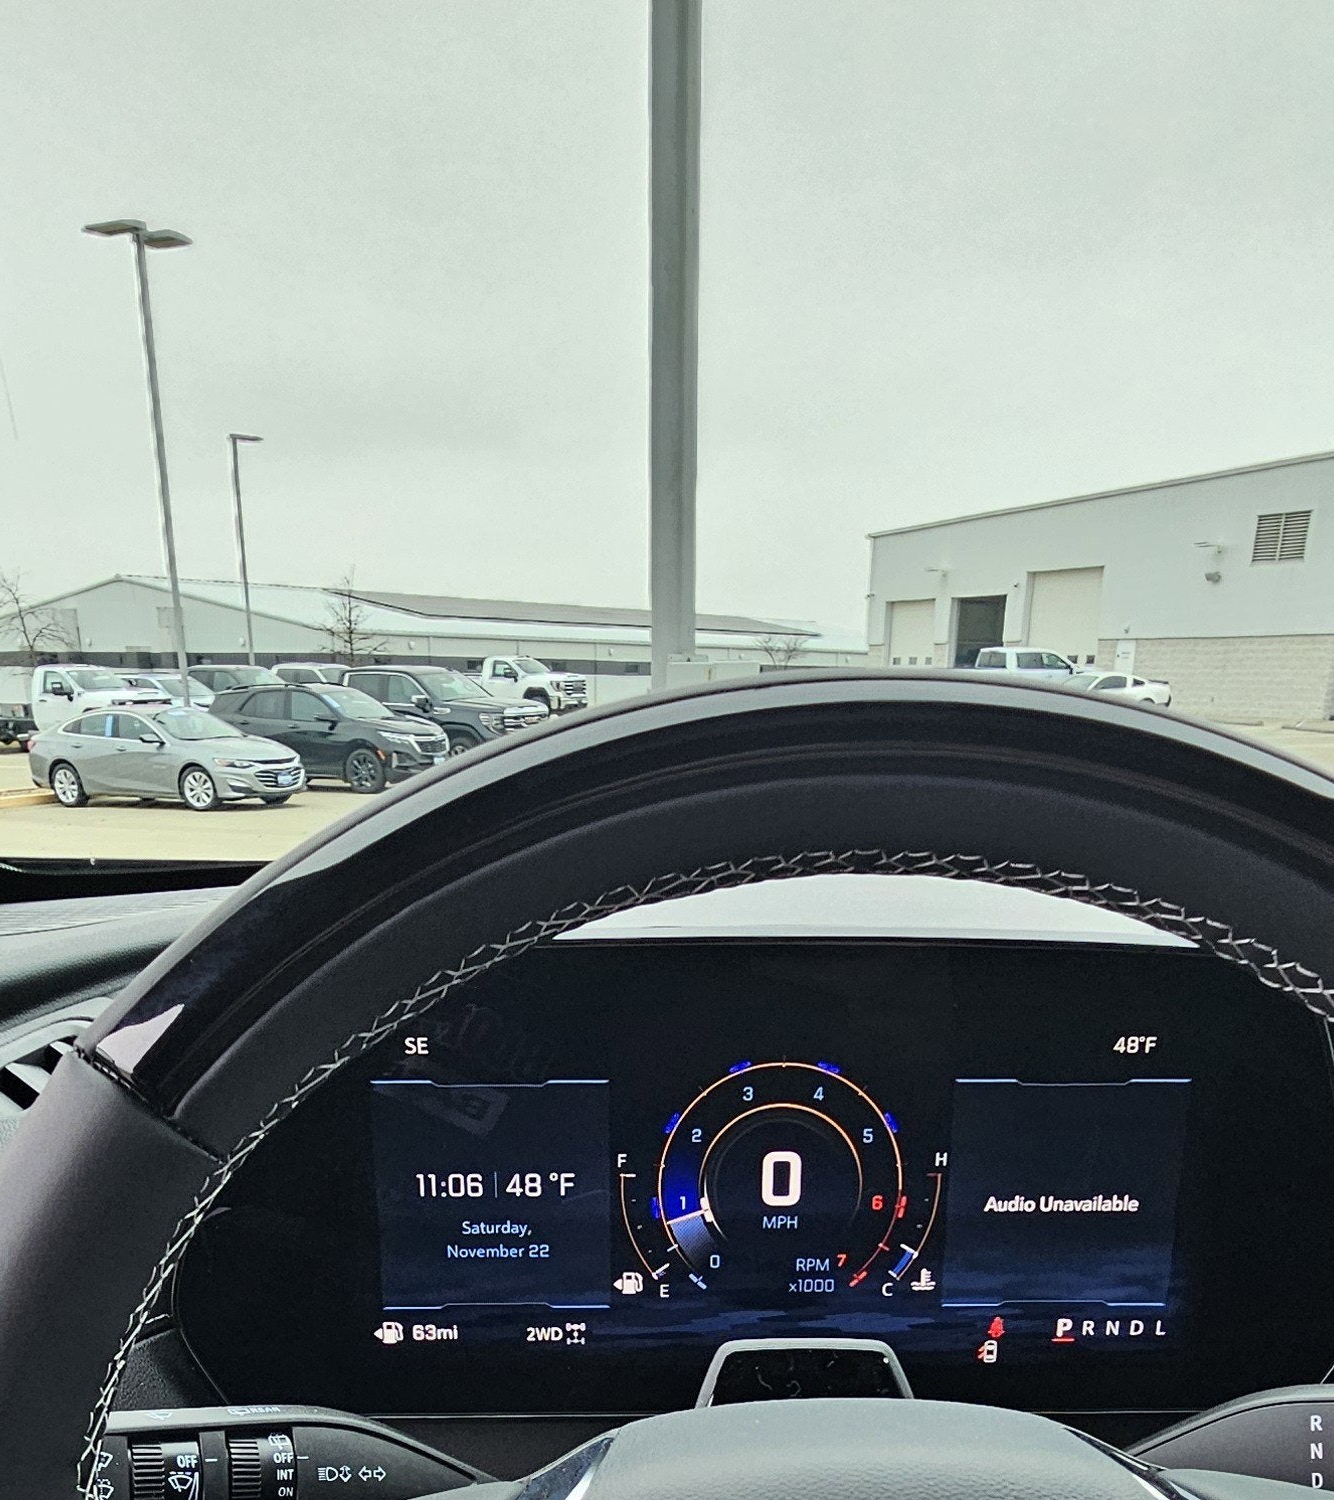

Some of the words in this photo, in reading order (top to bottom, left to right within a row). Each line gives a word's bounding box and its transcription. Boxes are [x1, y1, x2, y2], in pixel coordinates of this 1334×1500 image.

[405, 1037, 428, 1054] SE
[743, 1087, 753, 1101] 3
[814, 1087, 824, 1100] 4
[692, 1129, 701, 1142] 2
[863, 1129, 873, 1143] 5
[618, 1154, 627, 1167] F
[935, 1152, 947, 1166] H
[416, 1174, 483, 1197] 11:06
[506, 1173, 541, 1196] 48
[762, 1151, 801, 1206] 0
[680, 1196, 685, 1210] 1
[872, 1195, 883, 1210] 6
[984, 1195, 1036, 1212] Audio
[1040, 1195, 1139, 1212] Unavailable
[462, 1220, 531, 1237] Saturday,
[763, 1216, 797, 1228] MPH
[447, 1244, 524, 1258] November
[529, 1244, 549, 1257] 22
[710, 1255, 720, 1268] 0
[796, 1258, 829, 1271] RPM
[837, 1254, 846, 1266] 7
[660, 1284, 669, 1297] E
[789, 1279, 834, 1292] x1000
[882, 1283, 893, 1296] C
[413, 1324, 458, 1340] 63mi
[527, 1327, 563, 1341] 2WD
[1056, 1318, 1072, 1337] P
[1082, 1321, 1094, 1335] R
[1106, 1321, 1119, 1335] N
[1130, 1320, 1144, 1335] D
[1156, 1320, 1166, 1335] L
[1311, 1415, 1322, 1431] R
[273, 1452, 293, 1463] OFF
[1310, 1443, 1323, 1459] N
[177, 1455, 197, 1468] OFF
[277, 1470, 294, 1480] INT
[279, 1487, 293, 1497] ON
